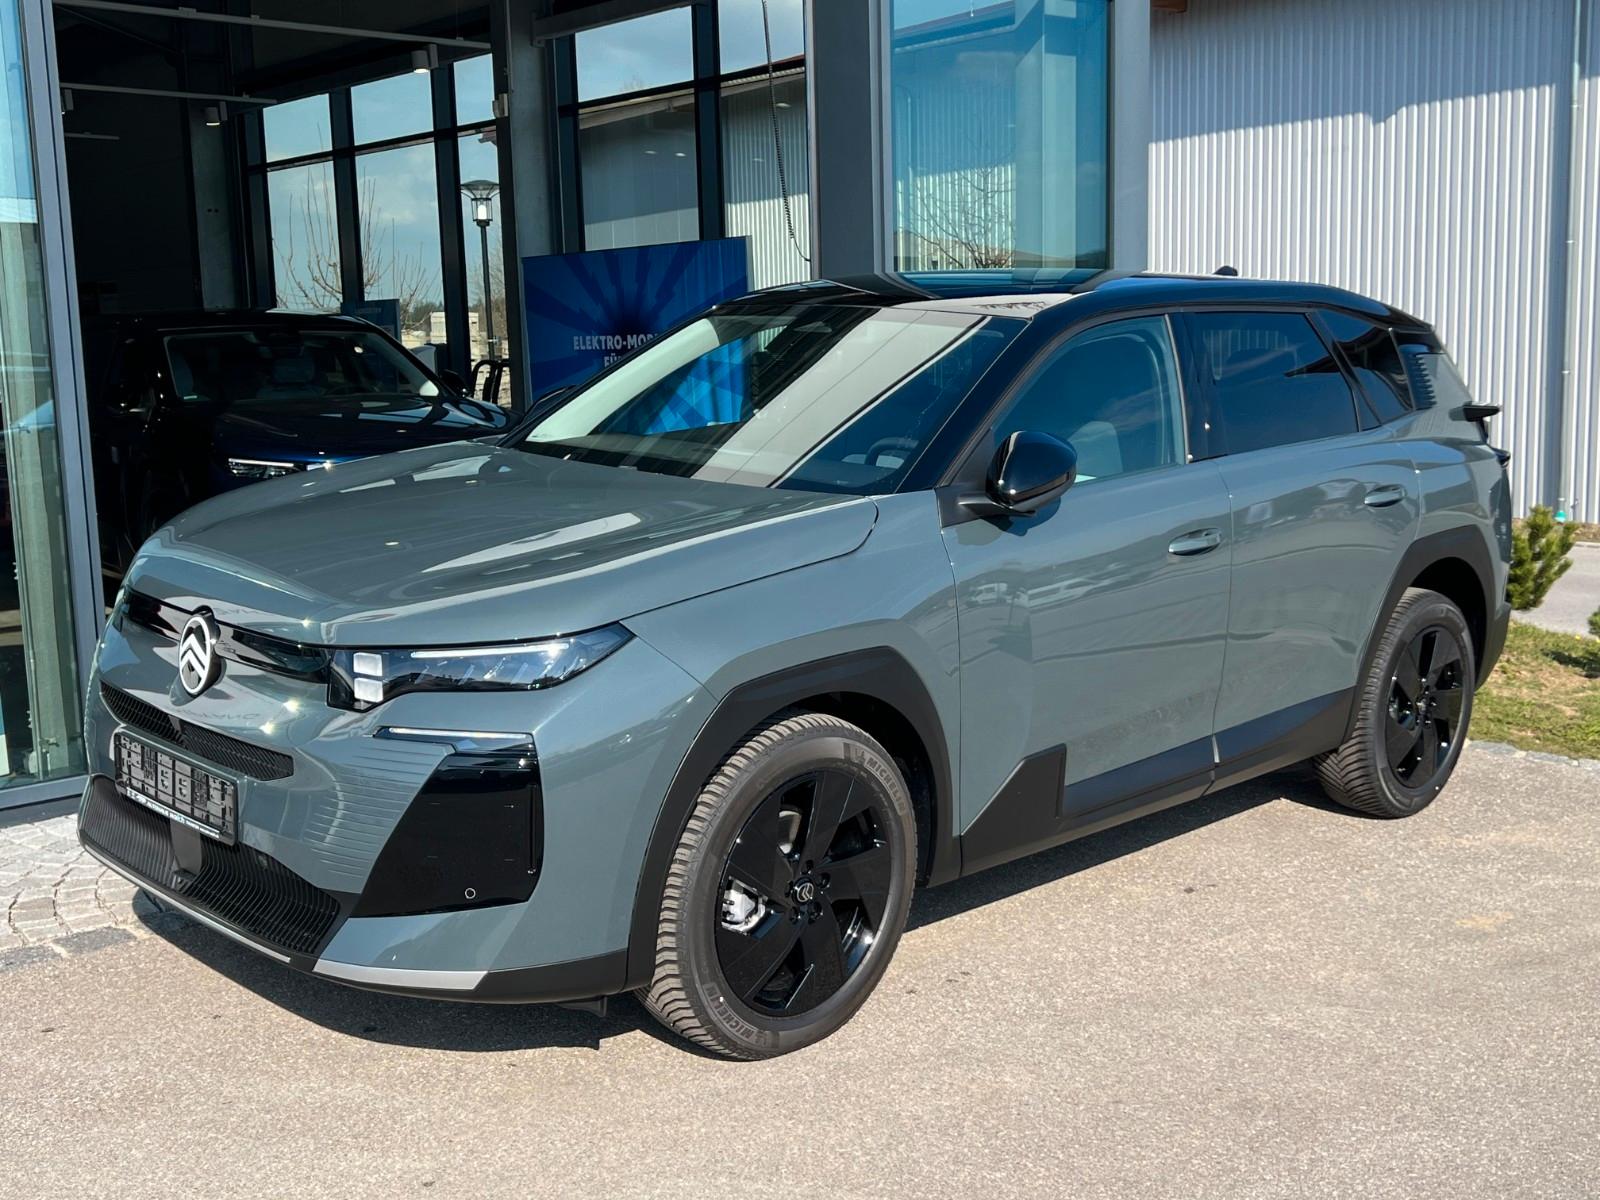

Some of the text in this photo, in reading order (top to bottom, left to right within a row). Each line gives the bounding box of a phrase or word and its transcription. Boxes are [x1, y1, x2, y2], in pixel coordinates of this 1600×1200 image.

[573, 333, 658, 351] ELEKTRO-MO
[866, 757, 906, 813] MICHELIN
[704, 985, 755, 1040] MICHELIN
